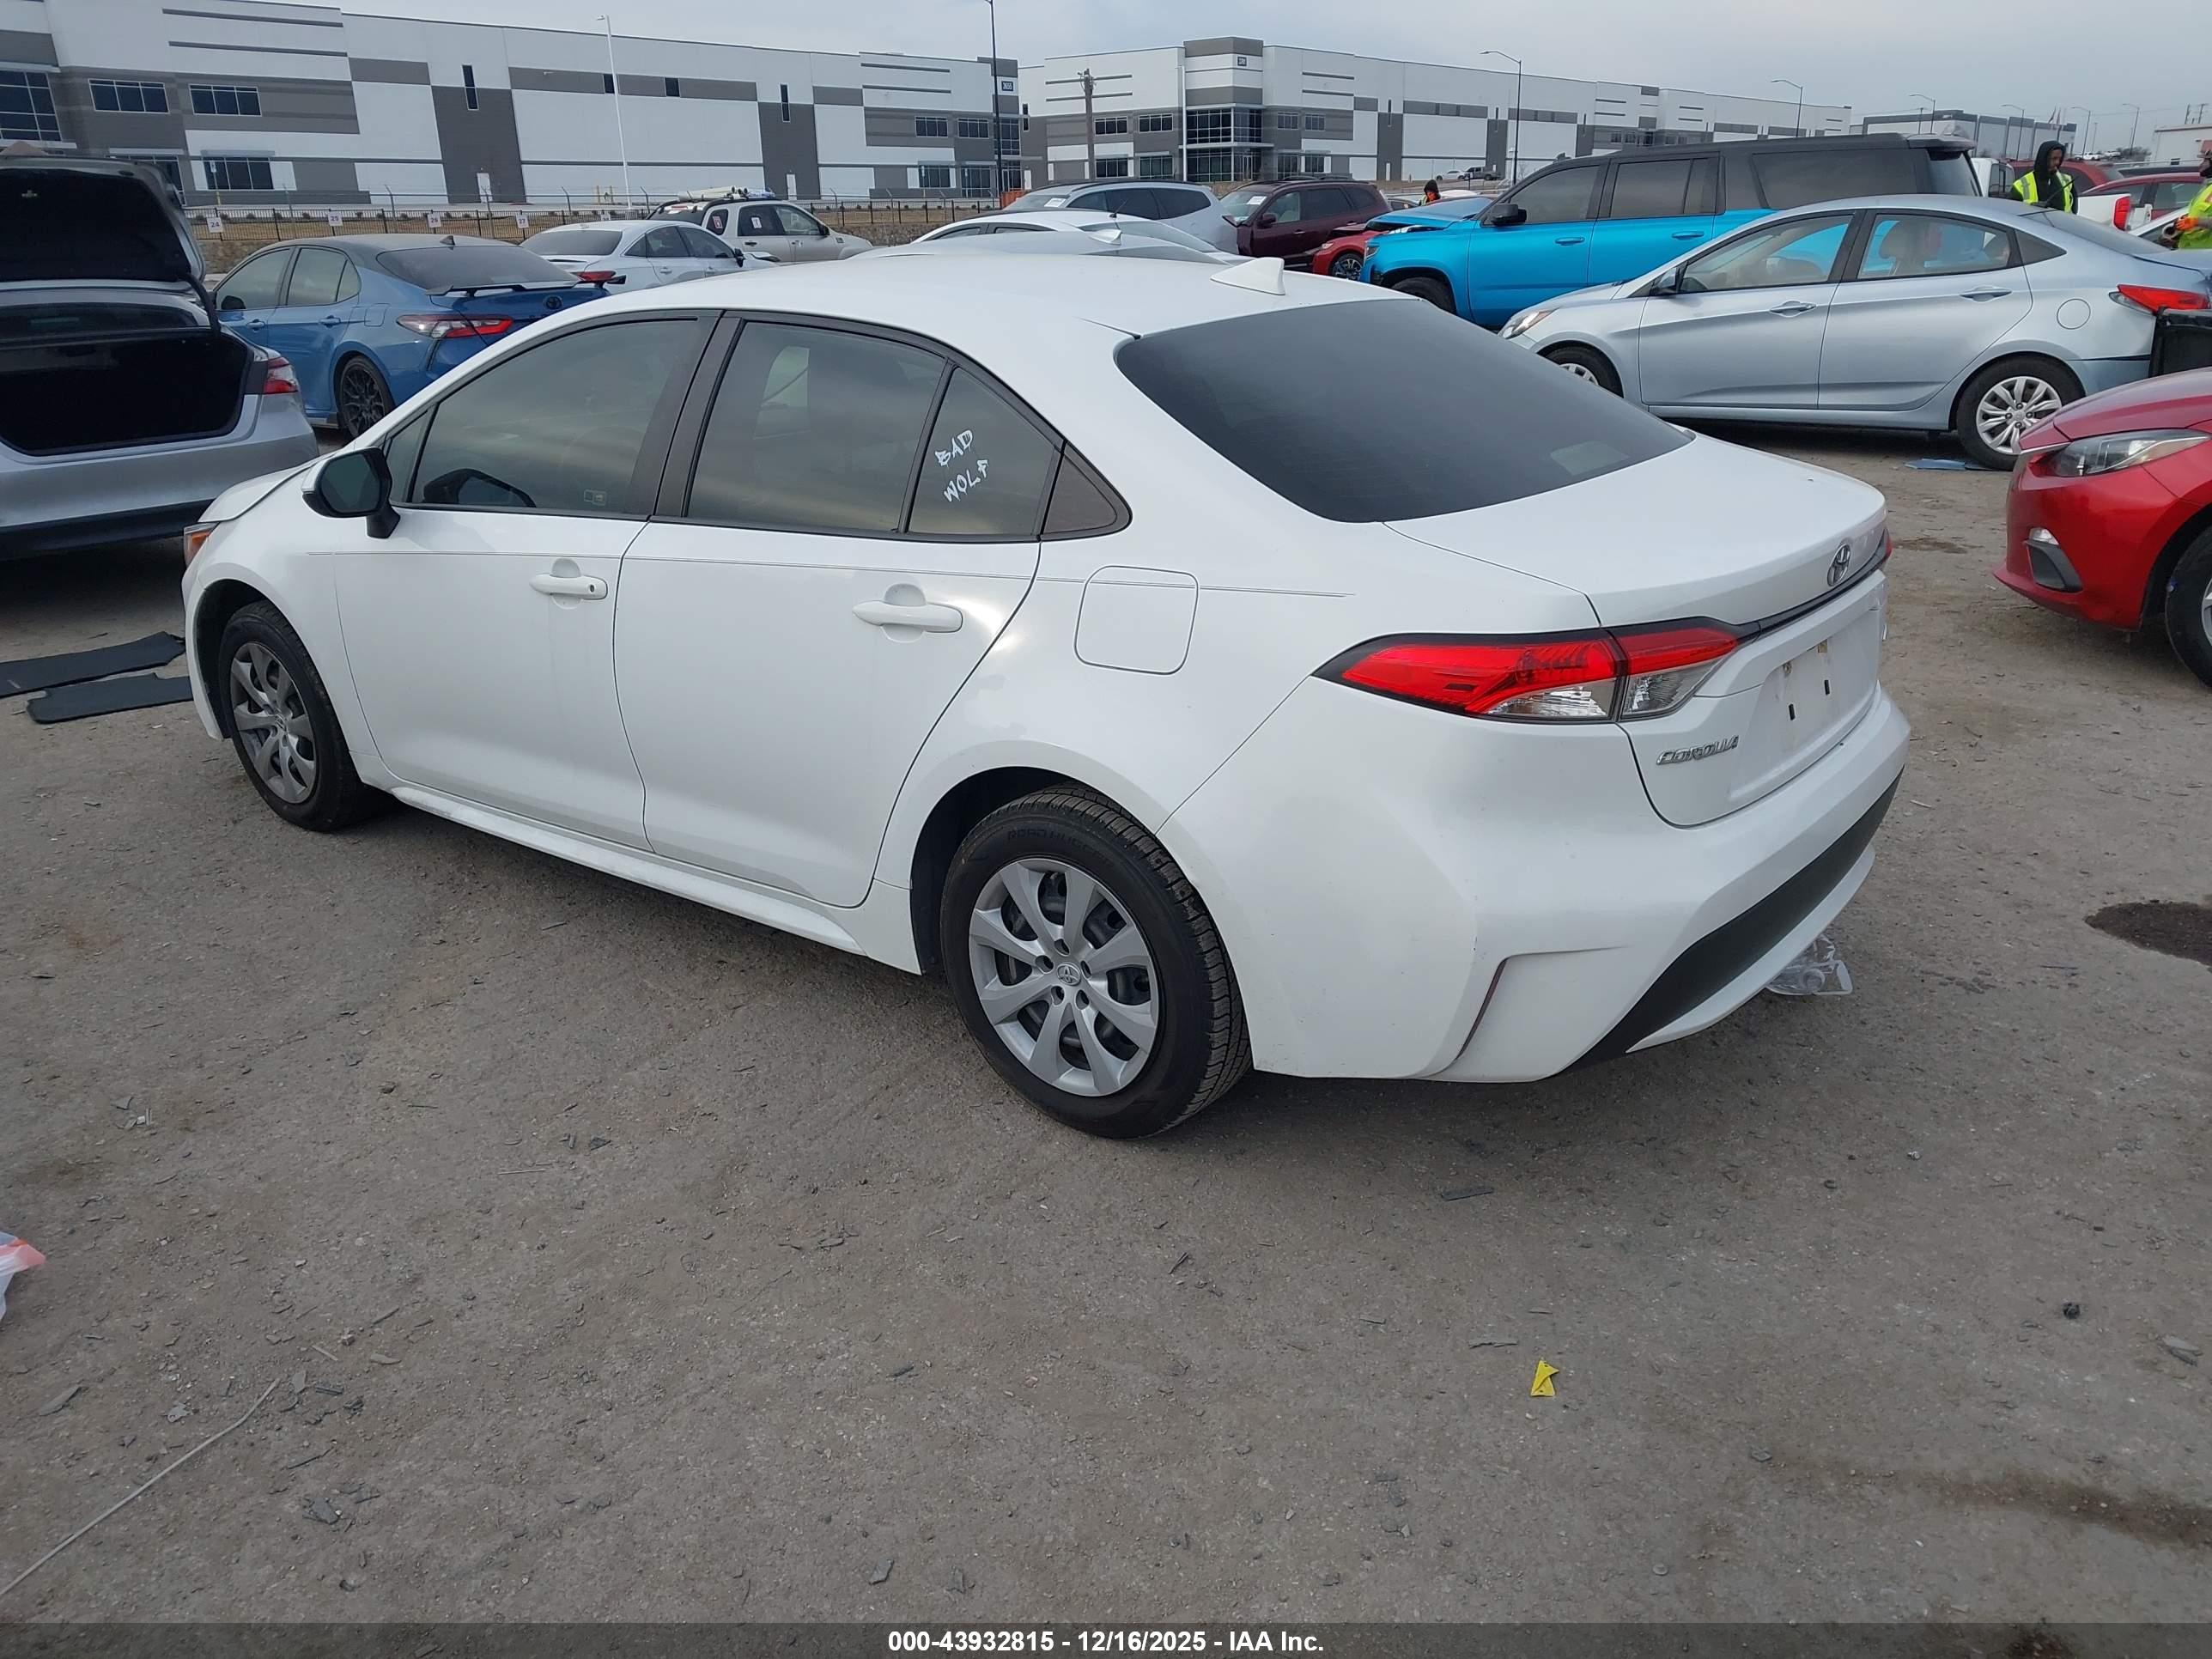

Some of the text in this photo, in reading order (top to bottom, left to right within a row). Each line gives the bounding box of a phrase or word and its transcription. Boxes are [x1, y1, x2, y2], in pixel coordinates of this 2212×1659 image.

[934, 429, 974, 466] BAD
[943, 459, 989, 501] WOLF
[1656, 734, 1740, 765] COROLLA
